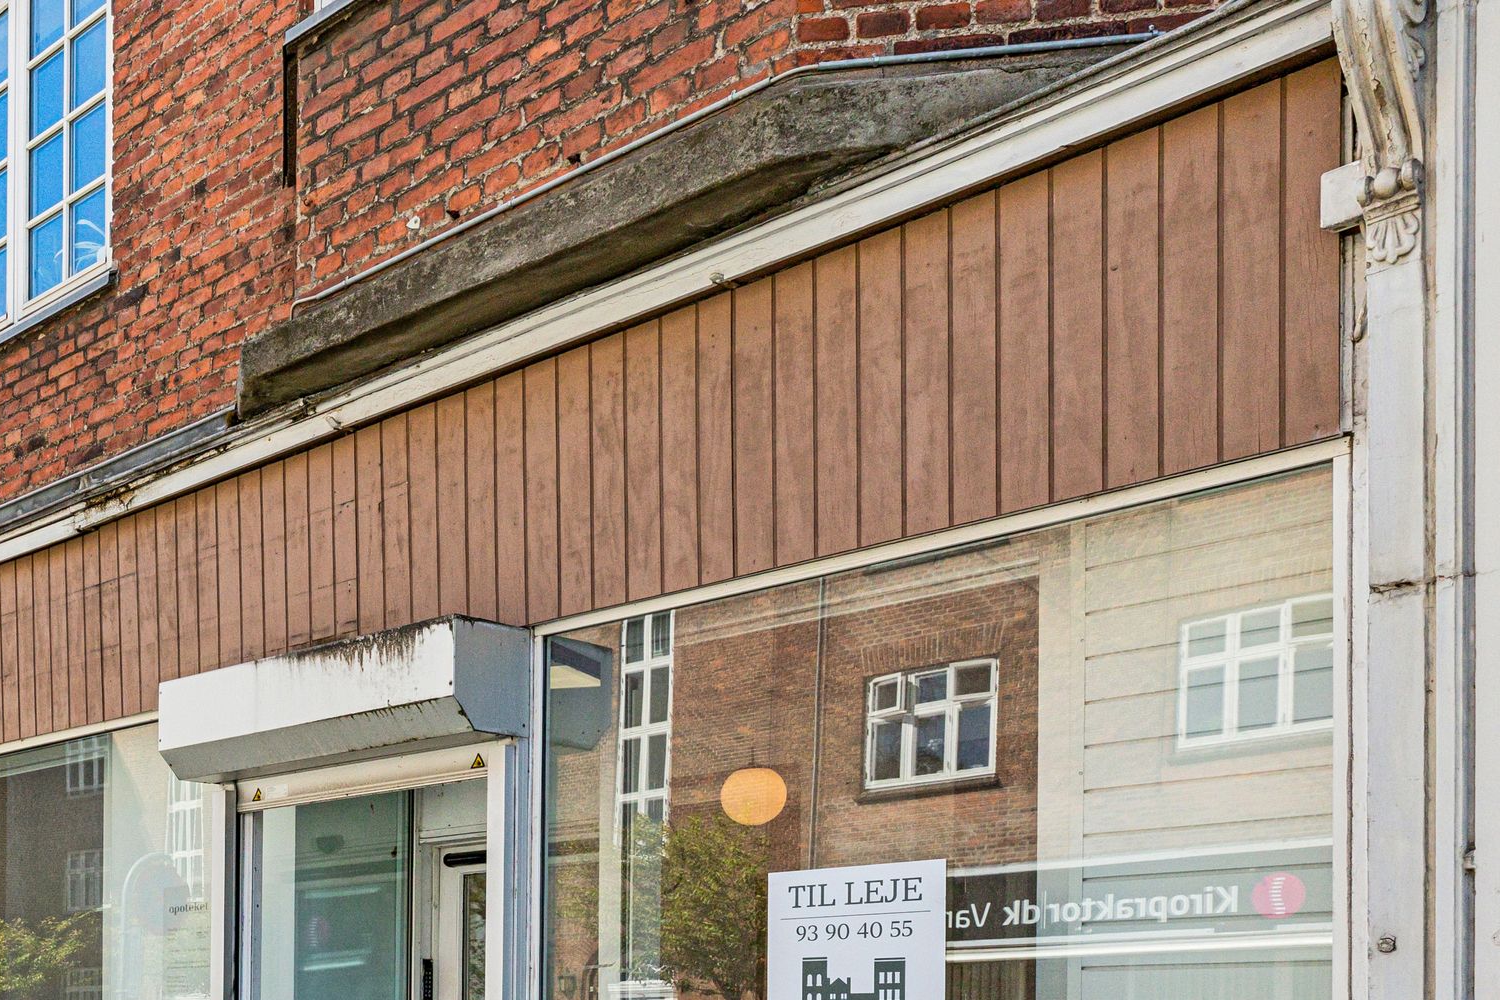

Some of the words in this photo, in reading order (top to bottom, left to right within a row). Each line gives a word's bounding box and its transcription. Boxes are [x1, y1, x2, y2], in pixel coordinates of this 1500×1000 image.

[788, 883, 836, 909] TIL
[844, 877, 923, 906] LEJE
[796, 924, 819, 942] 93
[825, 923, 850, 941] 90
[856, 921, 883, 939] 40
[890, 920, 913, 938] 55
